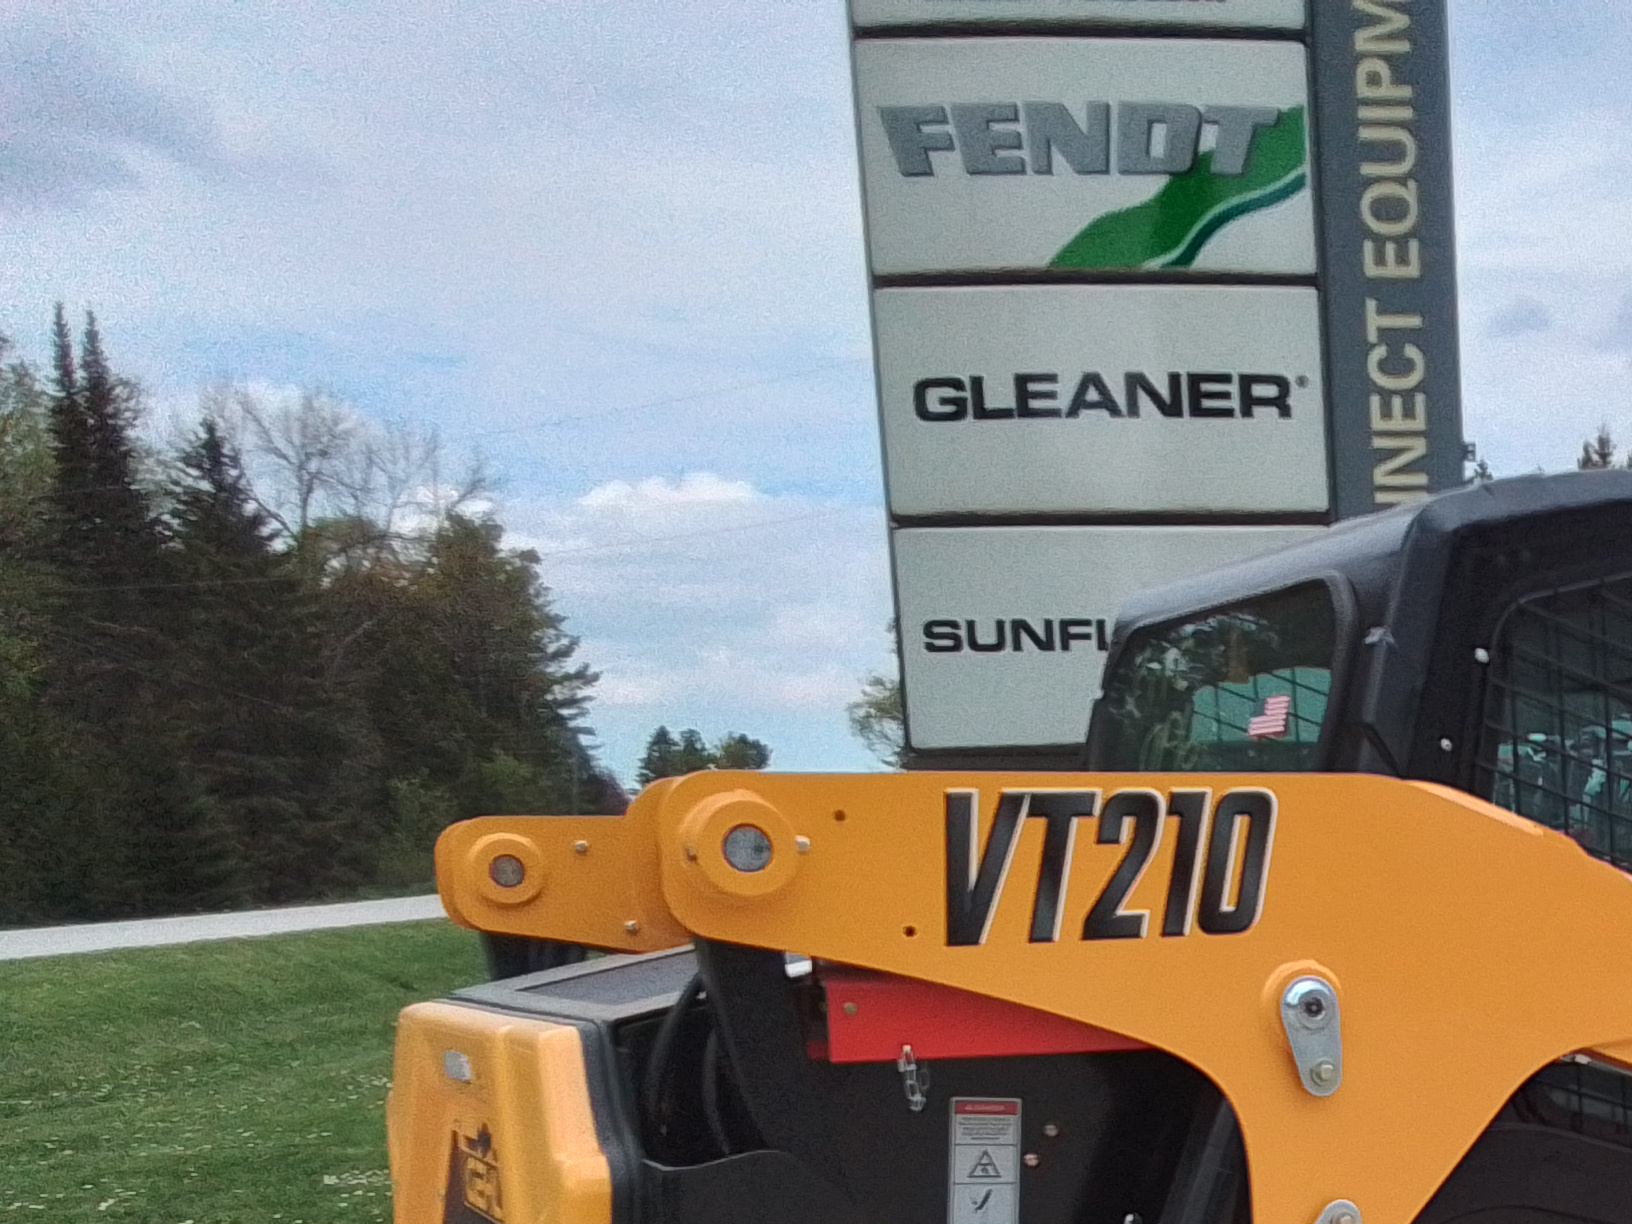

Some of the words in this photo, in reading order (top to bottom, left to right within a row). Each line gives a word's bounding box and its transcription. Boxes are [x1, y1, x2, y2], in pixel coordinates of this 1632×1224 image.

[877, 100, 1282, 177] FENDT
[912, 371, 1293, 423] GLEANER
[1366, 297, 1430, 504] NECT
[944, 787, 1279, 947] VT210
